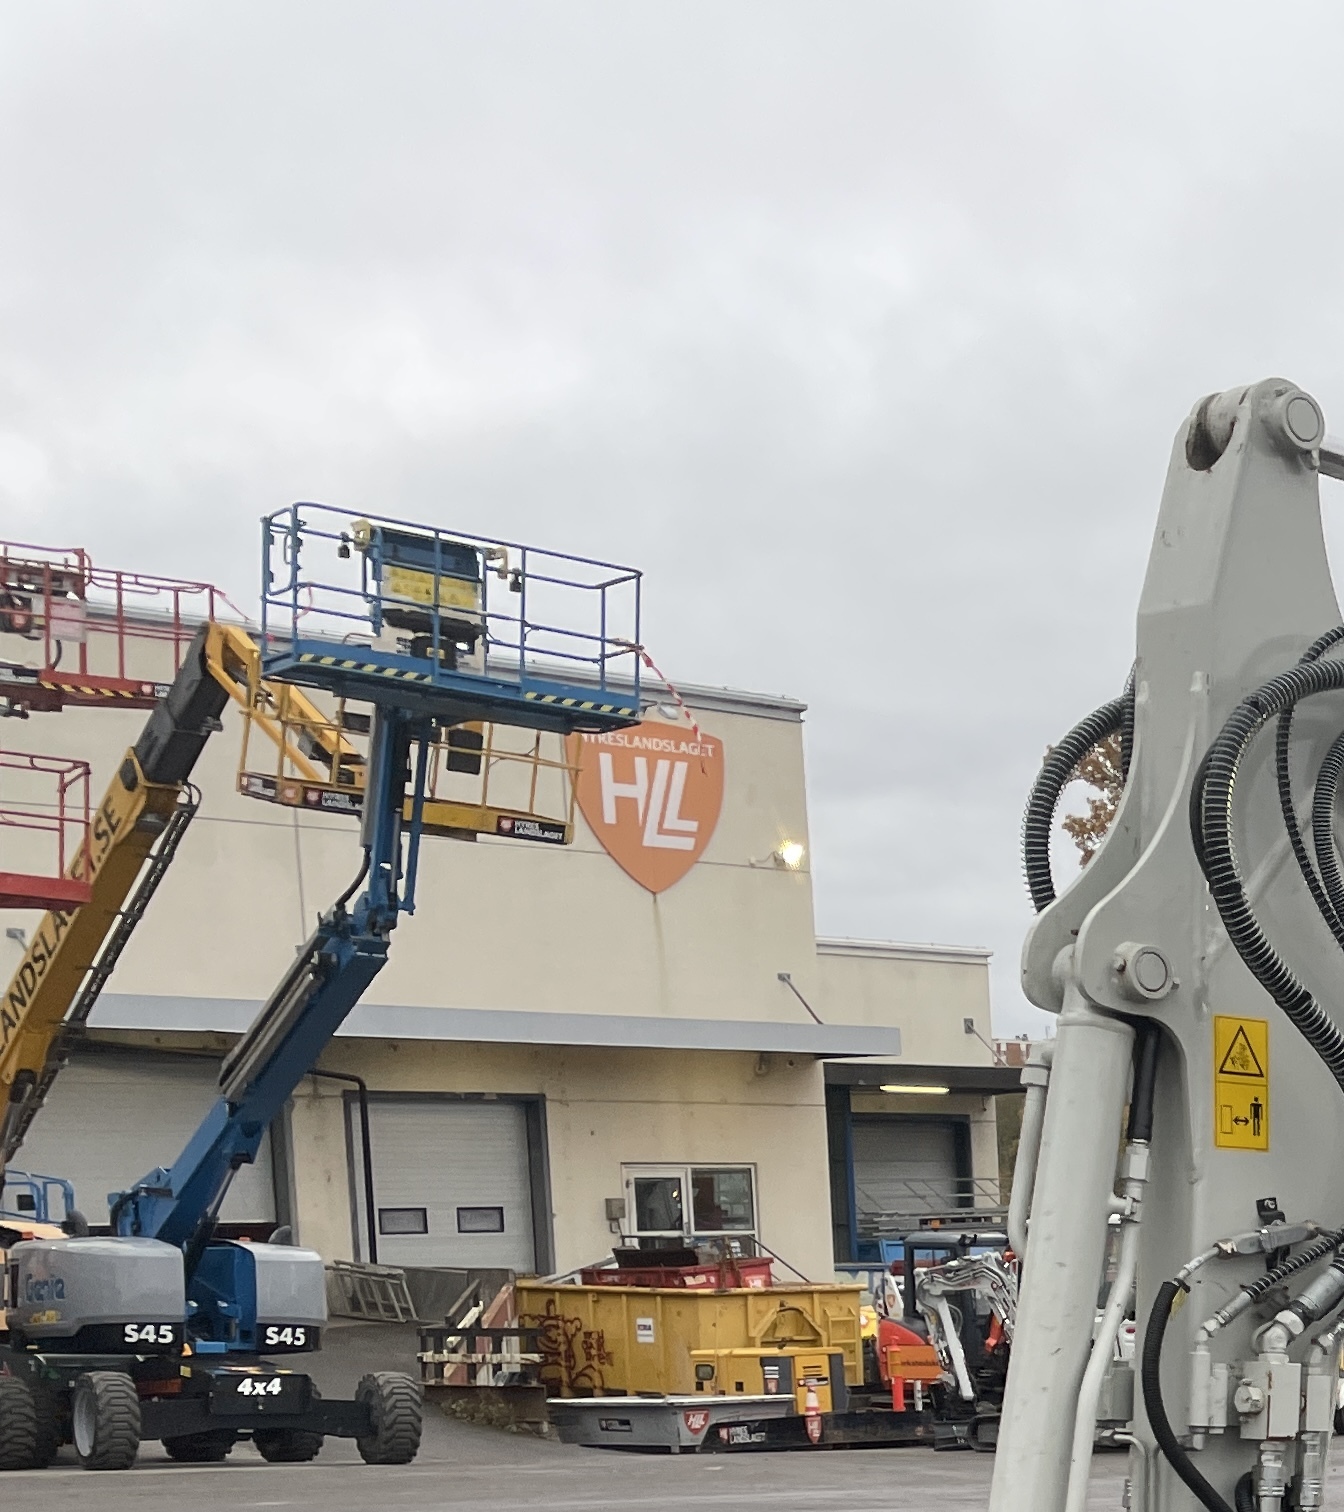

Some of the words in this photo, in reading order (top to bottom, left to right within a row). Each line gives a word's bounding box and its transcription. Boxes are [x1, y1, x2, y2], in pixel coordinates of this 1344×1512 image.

[124, 1323, 174, 1344] S45
[265, 1326, 305, 1346] S45
[237, 1377, 282, 1396] 4x4
